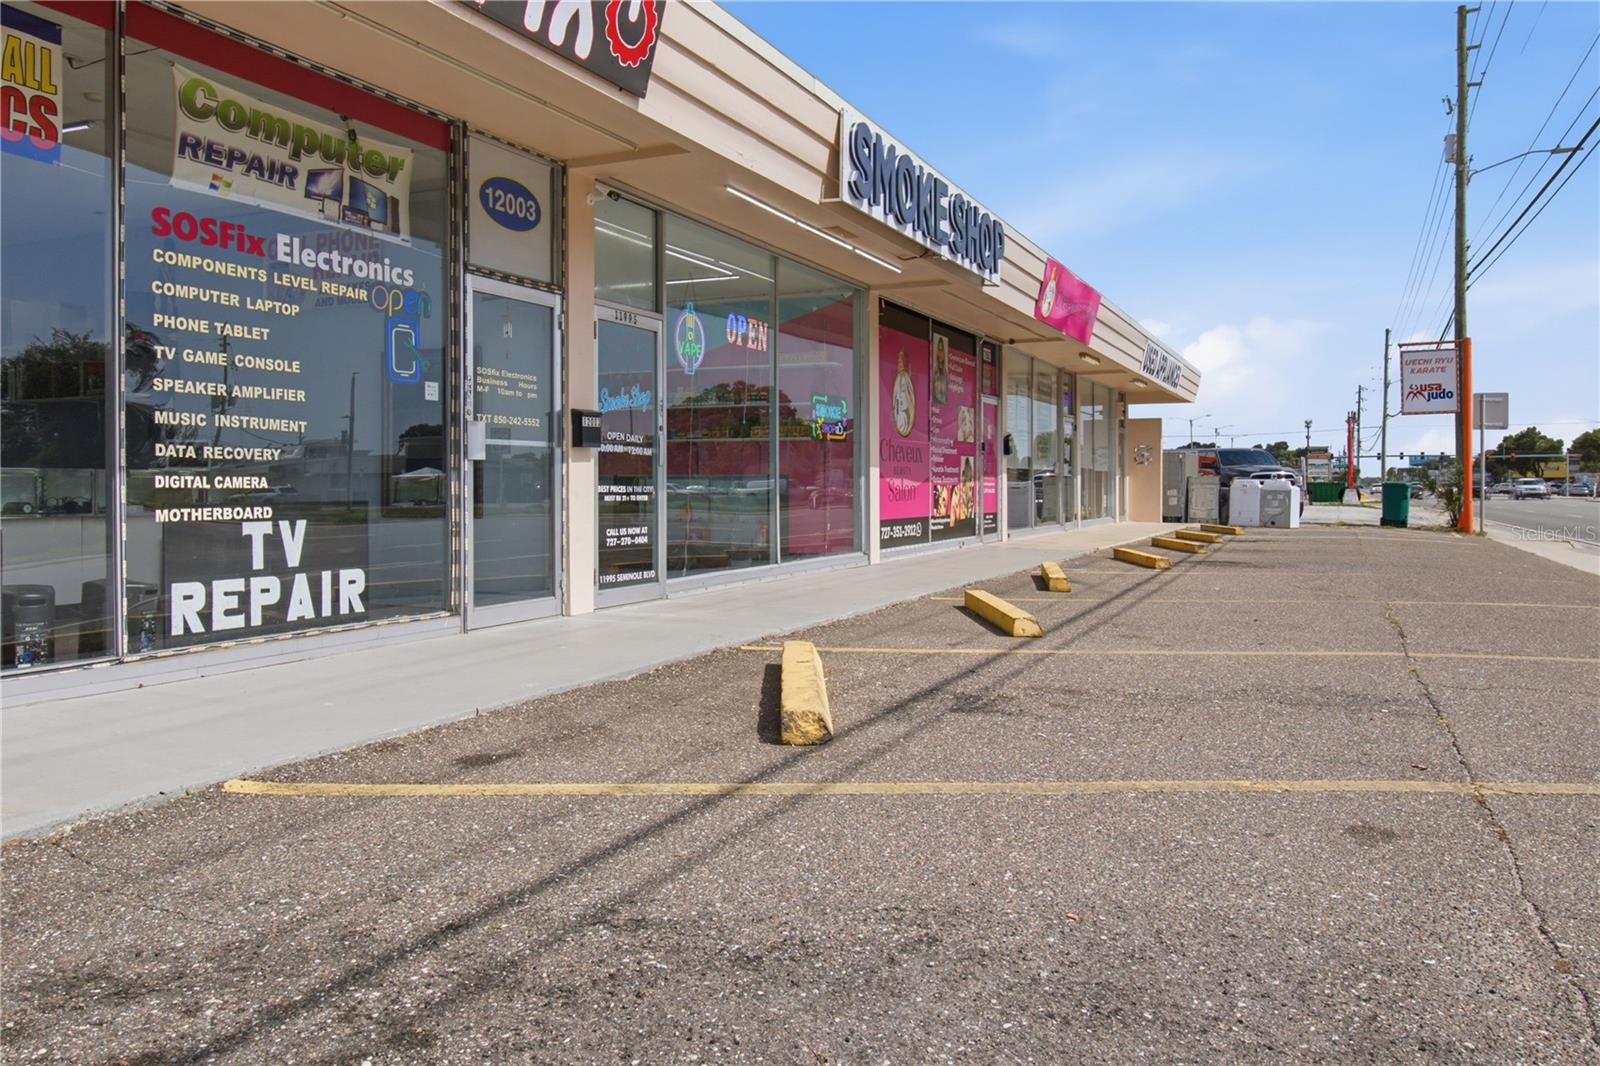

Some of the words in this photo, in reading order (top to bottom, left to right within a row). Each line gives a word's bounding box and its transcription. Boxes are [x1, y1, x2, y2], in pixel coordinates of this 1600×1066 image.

[2, 34, 57, 95] ALL
[178, 77, 406, 184] Computer
[178, 131, 299, 190] REPAIR
[485, 187, 536, 221] 12003
[848, 122, 948, 246] SMOKE
[948, 193, 1004, 274] SHOP
[151, 207, 265, 257] SOSFix
[276, 233, 414, 287] Electronics
[152, 249, 267, 283] COMPONENTS
[273, 271, 318, 292] LEVEL
[321, 281, 368, 302] REPAIR
[151, 280, 240, 307] COMPUTER
[246, 297, 300, 316] LAPTOP
[153, 314, 209, 334] PHONE
[214, 321, 270, 341] TABLET
[727, 314, 768, 352] OPEN
[154, 345, 176, 361] TV
[182, 349, 227, 366] GAME
[234, 354, 300, 373] CONSOLE
[680, 341, 702, 358] VAPE
[476, 376, 508, 386] Business
[518, 381, 537, 390] Hours
[1409, 367, 1447, 375] KARATE
[153, 377, 227, 397] SPEAKER
[232, 383, 306, 402] AMPLIFIER
[1420, 383, 1442, 391] usa
[1426, 388, 1454, 402] judo
[154, 411, 207, 427] MUSIC
[214, 414, 308, 433] INSTRUMENT
[476, 414, 493, 424] TXT
[607, 432, 625, 441] OPEN
[626, 433, 644, 443] DAILY
[155, 443, 196, 459] DATA
[203, 445, 281, 462] RECOVERY
[880, 438, 923, 463] Cheveux
[154, 475, 211, 489] DIGITAL
[214, 476, 268, 489] CAMERA
[610, 485, 626, 493] PRICES
[888, 478, 916, 502] Salon
[155, 506, 273, 523] MOTHERBOARD
[606, 528, 619, 536] CALL
[627, 527, 640, 535] NOW
[641, 526, 648, 534] AT
[242, 519, 307, 571] TV
[600, 575, 616, 584] 11995
[617, 572, 643, 582] SEMINOLE
[643, 570, 656, 579] BLVD
[171, 568, 366, 636] REPAIR
